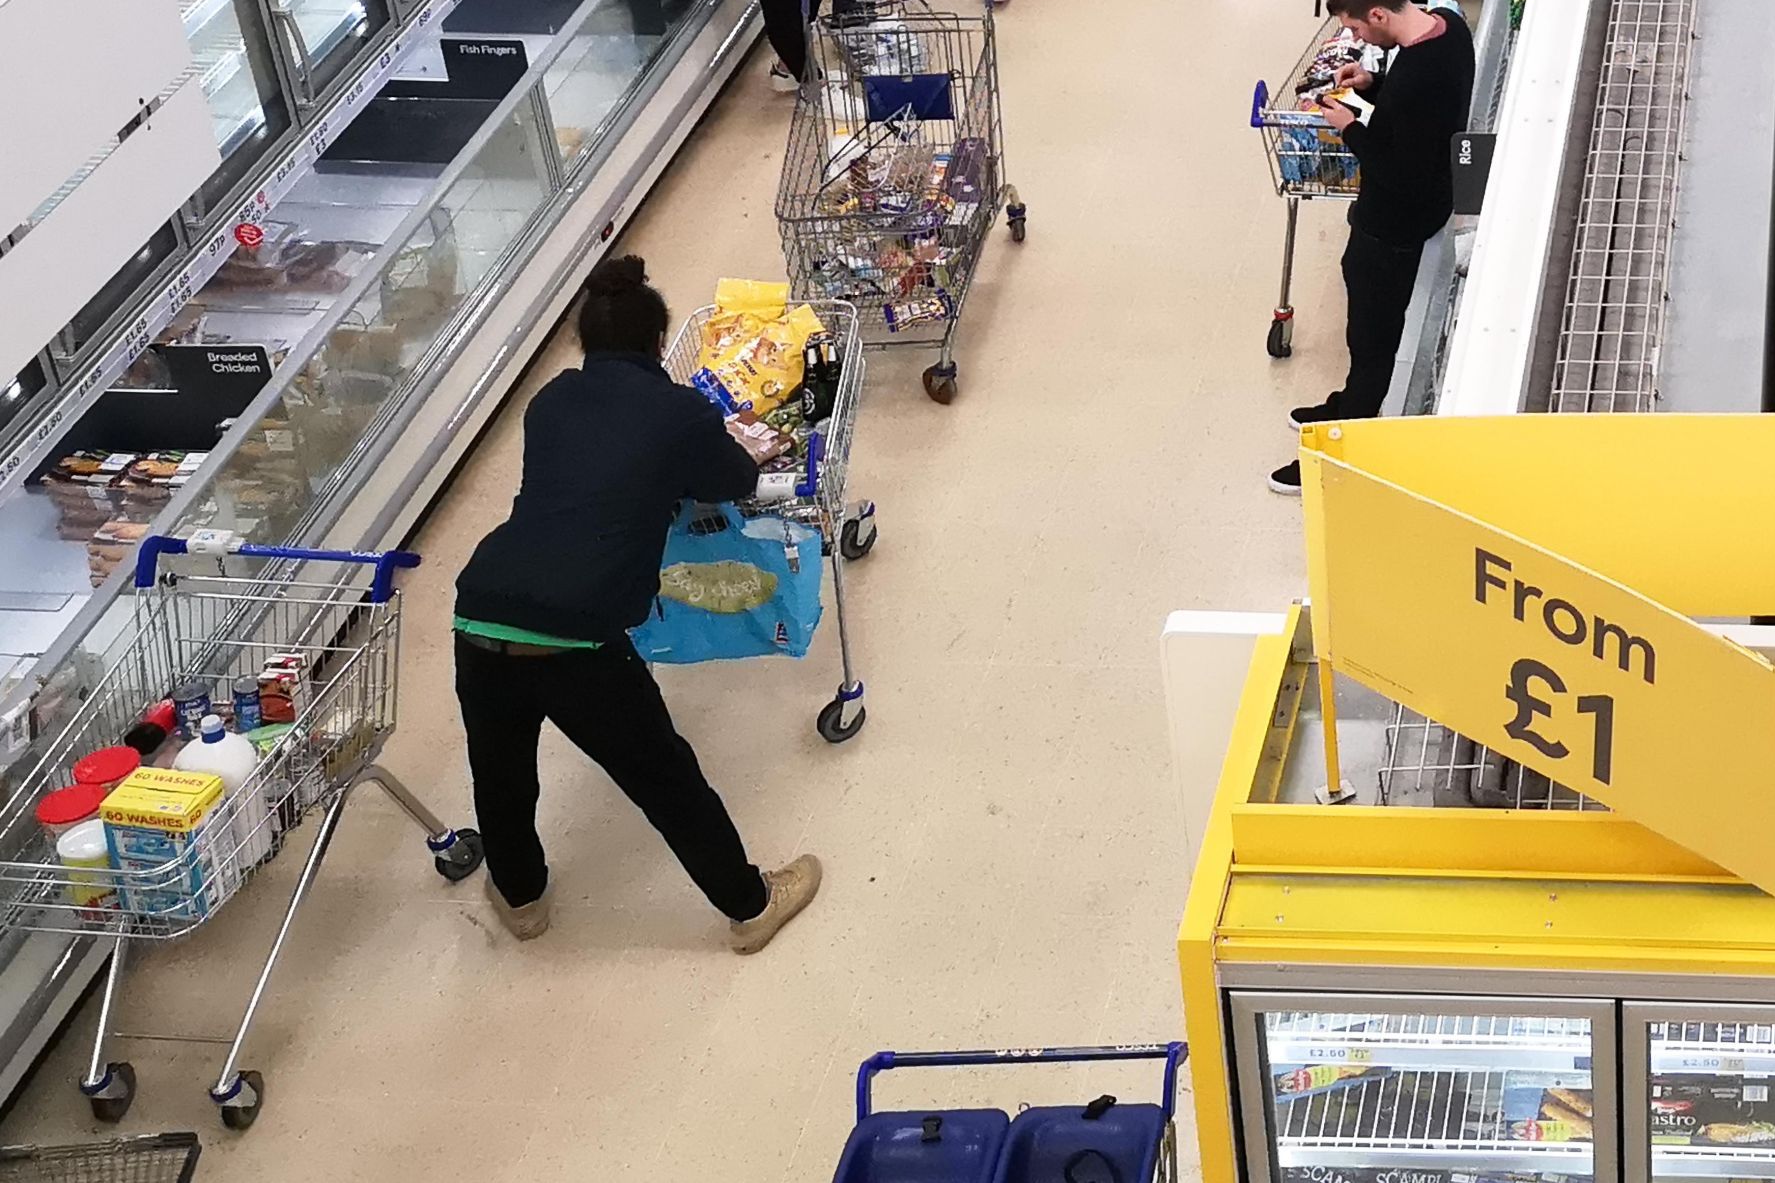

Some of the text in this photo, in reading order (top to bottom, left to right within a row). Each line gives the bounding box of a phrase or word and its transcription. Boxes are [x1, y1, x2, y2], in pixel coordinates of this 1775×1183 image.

[459, 45, 517, 57] Fish Fingers
[379, 53, 391, 69] £3
[315, 141, 327, 156] £3
[1459, 139, 1472, 164] Rice
[208, 233, 227, 256] 97P
[168, 271, 190, 300] £1.65
[170, 286, 193, 316] £1.65
[128, 333, 151, 362] £1.65
[208, 352, 258, 363] Breaded
[211, 362, 261, 374] Chicken
[1474, 546, 1656, 685] From
[1503, 657, 1615, 787] £1
[134, 772, 205, 787] 60 WASHES
[106, 810, 184, 829] 60 WASHES
[189, 808, 202, 825] 60
[1651, 1113, 1697, 1128] astro
